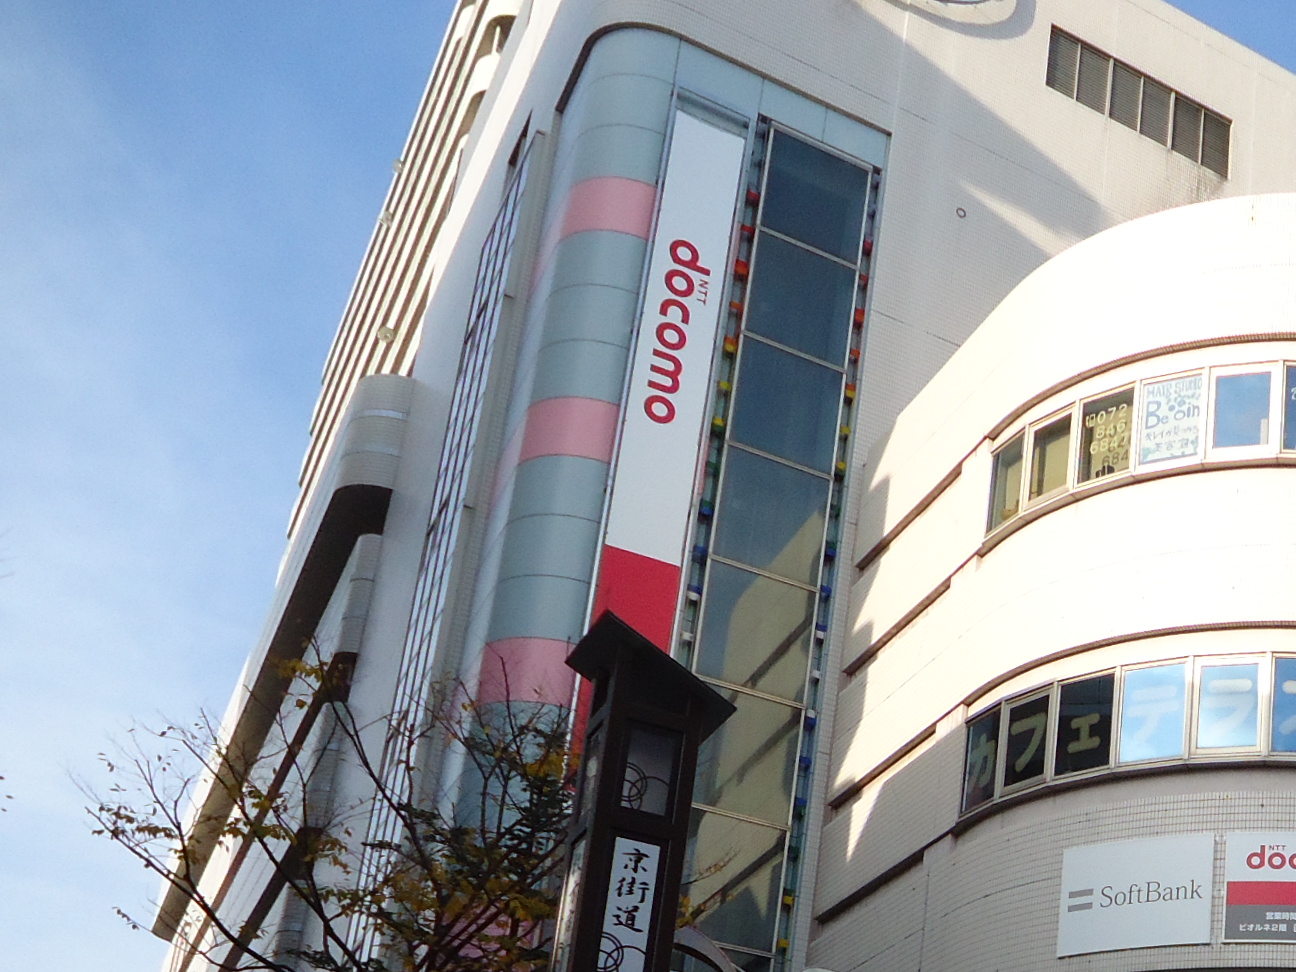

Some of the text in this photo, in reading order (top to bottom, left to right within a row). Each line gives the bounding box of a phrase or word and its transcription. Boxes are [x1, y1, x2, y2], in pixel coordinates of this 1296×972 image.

[696, 278, 709, 306] NTT
[644, 239, 711, 424] docomo
[1097, 403, 1128, 424] 072
[1096, 419, 1126, 439] 846
[612, 847, 650, 934] 京街道
[1099, 879, 1204, 909] SoftBank
